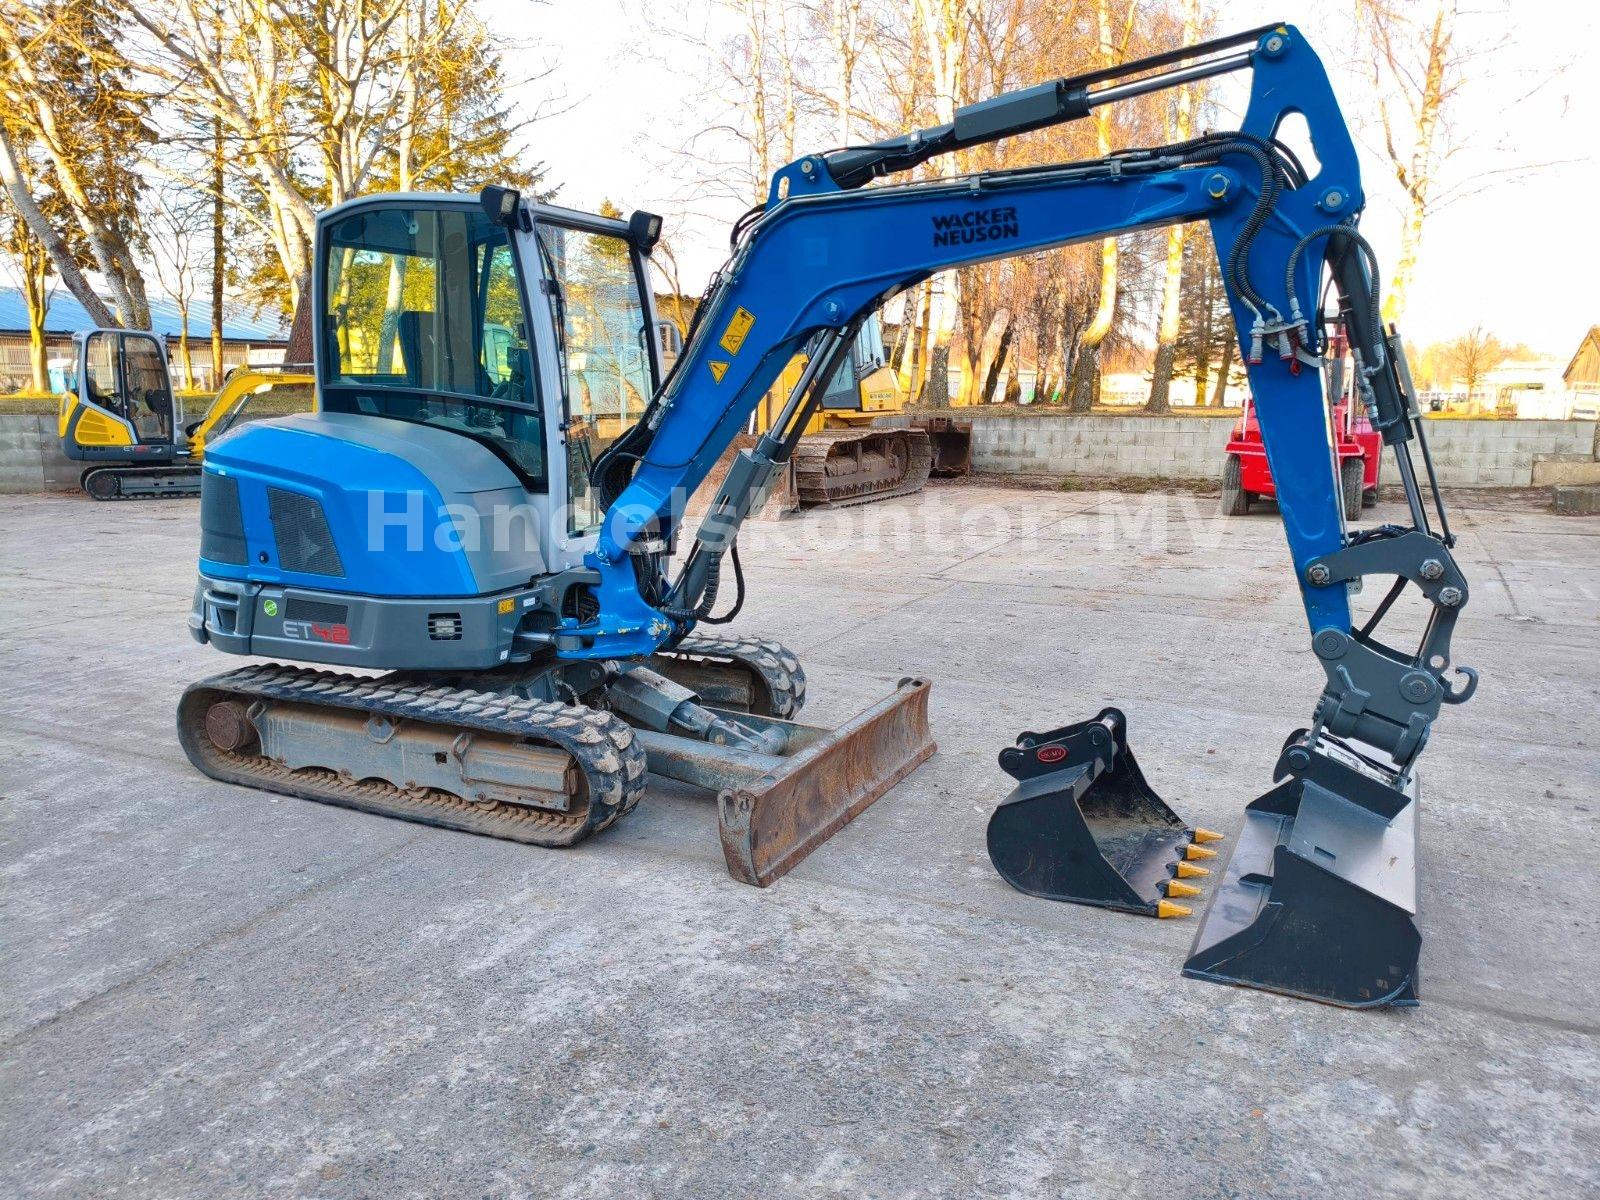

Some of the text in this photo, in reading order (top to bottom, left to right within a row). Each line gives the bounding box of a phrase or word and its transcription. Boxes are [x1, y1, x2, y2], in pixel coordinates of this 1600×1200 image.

[932, 207, 1017, 230] WACKER
[934, 223, 1019, 247] NEUSON
[283, 621, 350, 643] ET42
